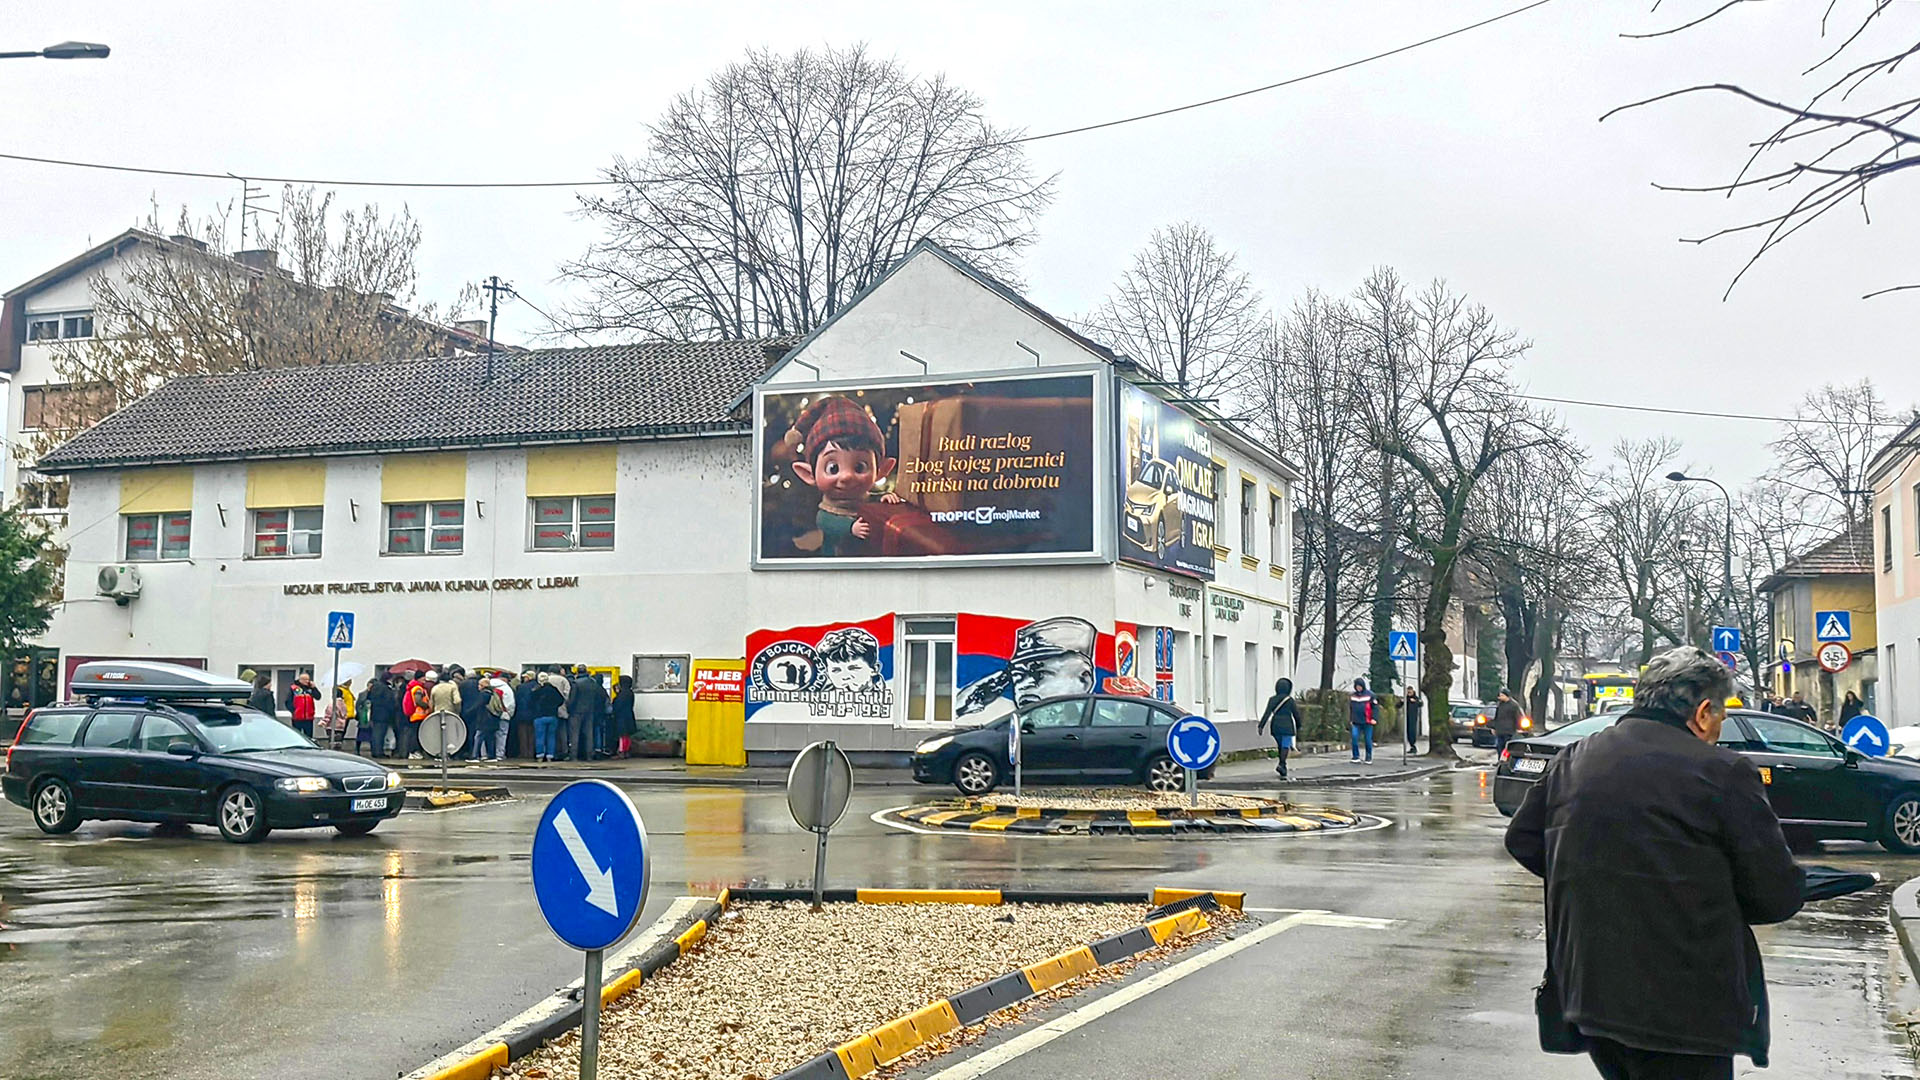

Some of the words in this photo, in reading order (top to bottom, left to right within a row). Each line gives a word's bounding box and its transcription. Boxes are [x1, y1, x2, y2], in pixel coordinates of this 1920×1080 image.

[938, 436, 976, 451] Budi
[980, 432, 1032, 451] razlog
[905, 457, 945, 476] zbog
[948, 456, 992, 474] kojeg
[995, 451, 1065, 473] praznici
[910, 477, 962, 493] mirišu
[967, 477, 989, 491] na
[992, 474, 1060, 491] dobrotu
[930, 511, 974, 522] TROPIC
[992, 509, 1041, 522] mojMarket
[1177, 490, 1214, 523] NAGRADNA
[1191, 520, 1214, 551] IGRA
[283, 584, 324, 596] MOZAIK
[327, 581, 405, 595] PRIJATELJSTVA
[407, 581, 443, 593] JAVNA
[445, 579, 490, 592] KUHINJA
[492, 578, 533, 591] OBROK
[537, 576, 579, 589] LJUBAVI
[697, 670, 743, 681] HLJEB
